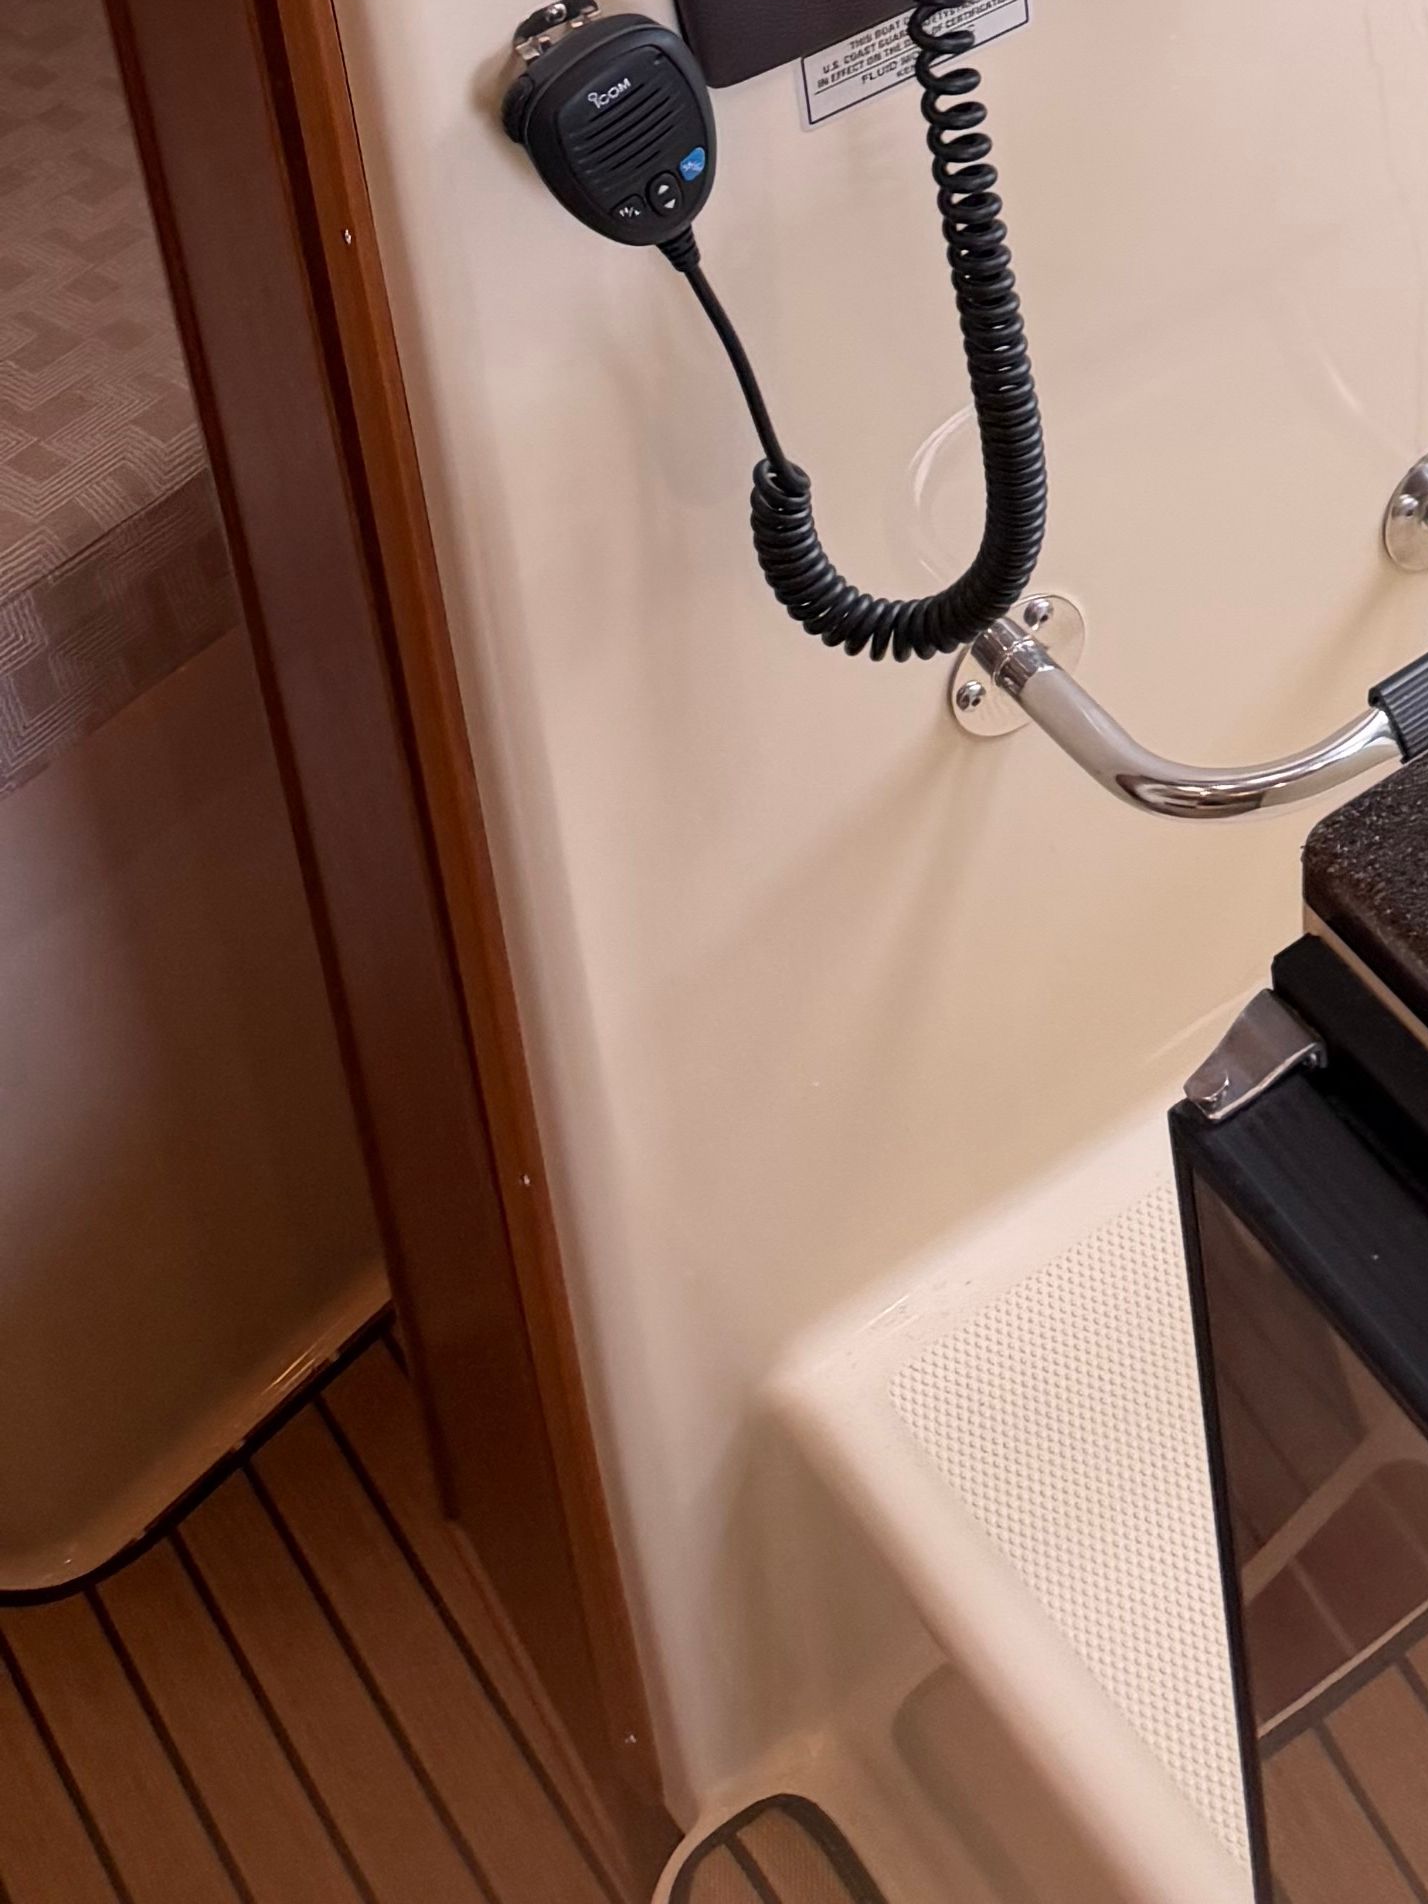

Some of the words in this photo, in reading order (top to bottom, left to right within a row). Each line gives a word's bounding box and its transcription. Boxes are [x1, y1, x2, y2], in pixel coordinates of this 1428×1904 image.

[849, 34, 871, 48] THIS
[873, 21, 900, 37] BOAT
[816, 77, 828, 87] IN
[829, 60, 865, 81] EFFECT
[866, 53, 881, 64] ON
[883, 43, 902, 56] THE
[842, 44, 875, 63] COAST
[861, 61, 898, 82] FLUID
